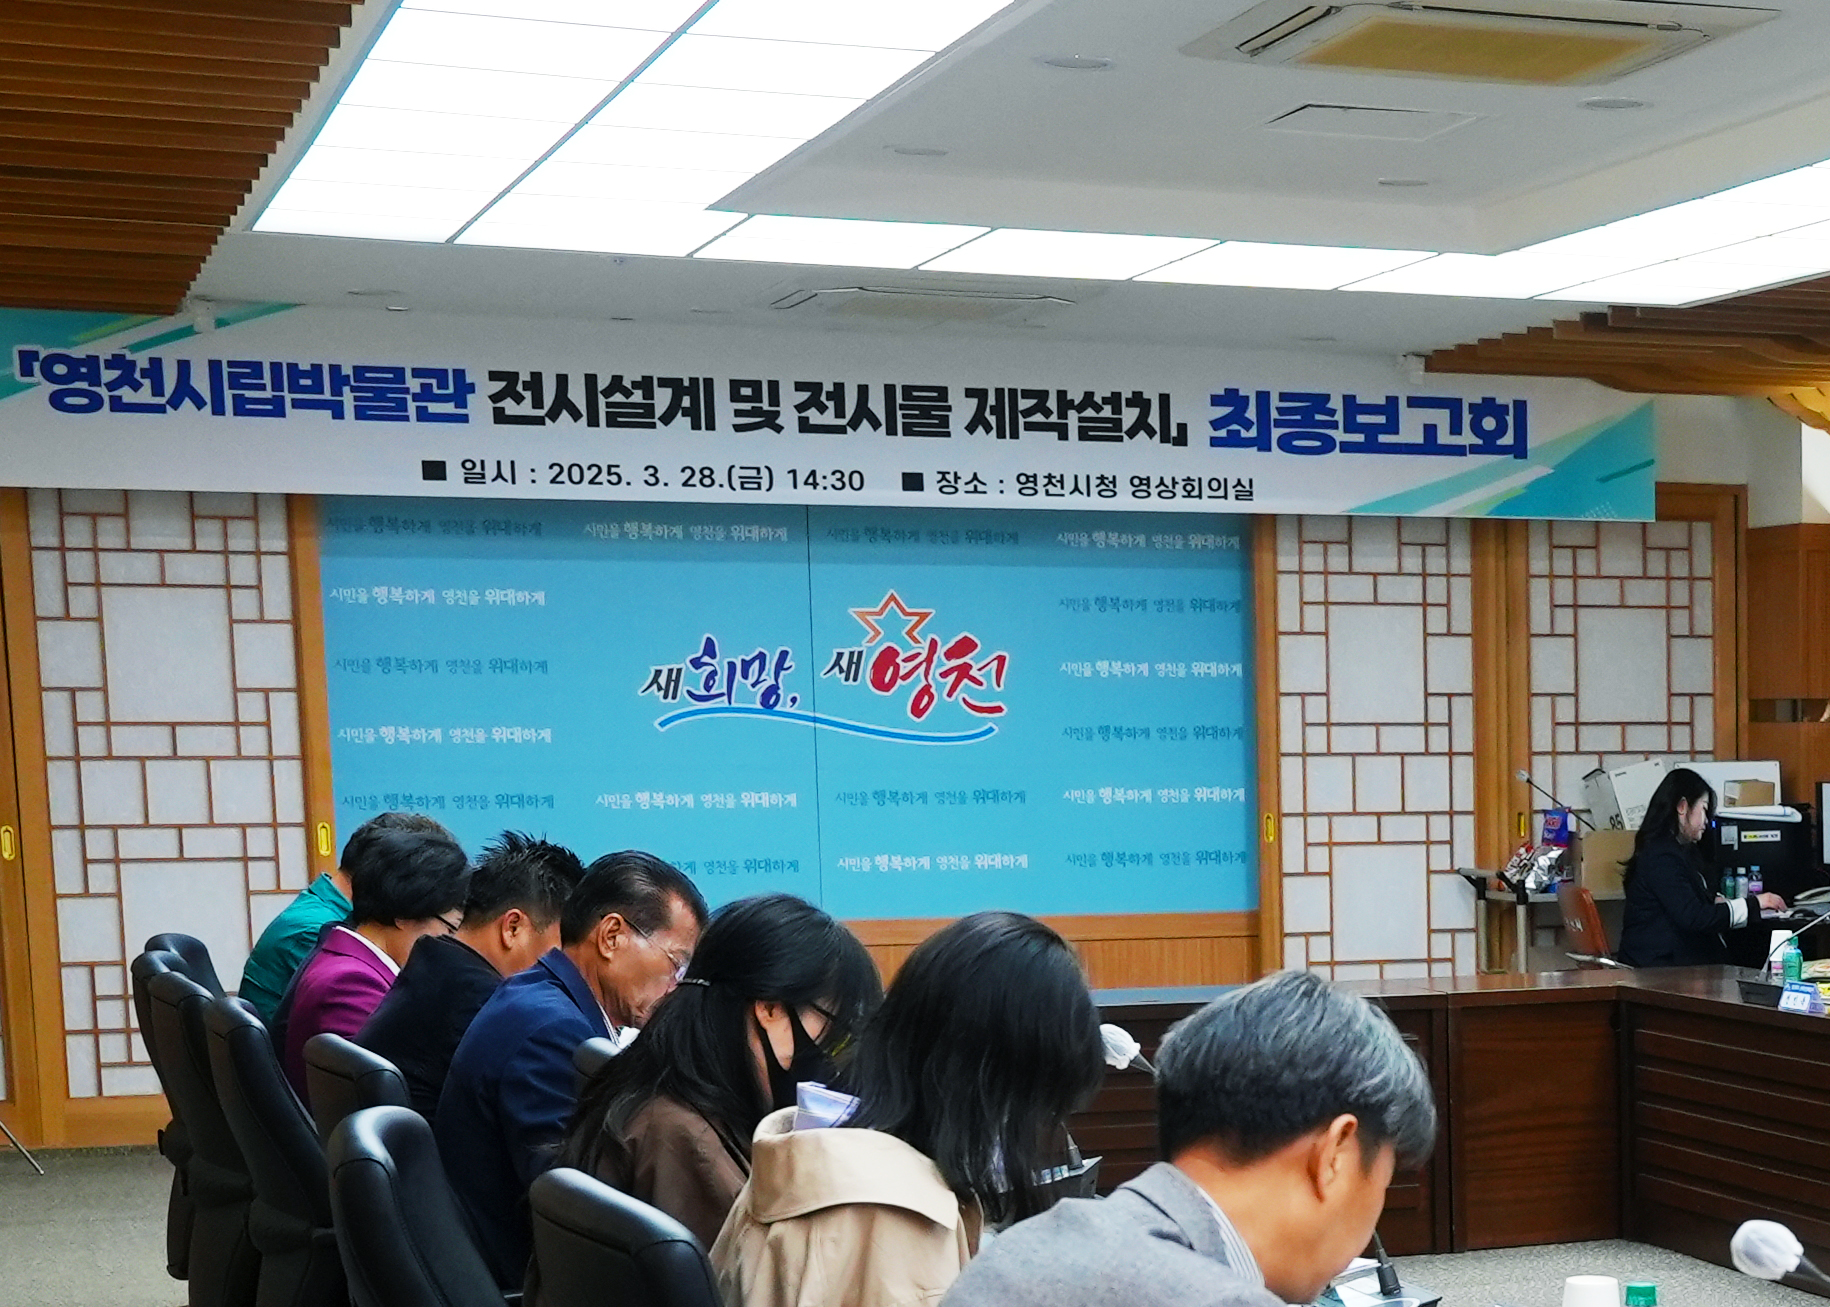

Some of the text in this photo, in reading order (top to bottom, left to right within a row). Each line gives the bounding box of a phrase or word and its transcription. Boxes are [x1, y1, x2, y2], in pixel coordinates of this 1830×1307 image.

[488, 369, 716, 431] 전시설계
[729, 378, 784, 434] 및
[794, 380, 952, 438] 전시물
[1208, 388, 1529, 460] 최종보고회
[461, 458, 517, 485] 일시
[548, 461, 632, 487] 2025.
[643, 464, 669, 488] 3.
[680, 465, 774, 492] 28.(금)
[787, 468, 866, 492] 14:30
[935, 470, 988, 495] 장소
[1015, 471, 1118, 498] 영천시청
[1129, 474, 1255, 501] 영상회의실
[330, 586, 545, 606] 시민을 행복하게 영천을 위대하게
[1060, 660, 1243, 678] 시민을 행복하게 영천을 위대하게
[337, 726, 551, 745] 시민을 행복하게 영천을 위대하게
[596, 792, 797, 809] 시민을 행복하게 영천을 위대하게
[1063, 786, 1246, 804] 시민을 행복하게 영천을 위대하게
[837, 853, 1028, 872] 시민을 행복하게 영천을 위대하게
